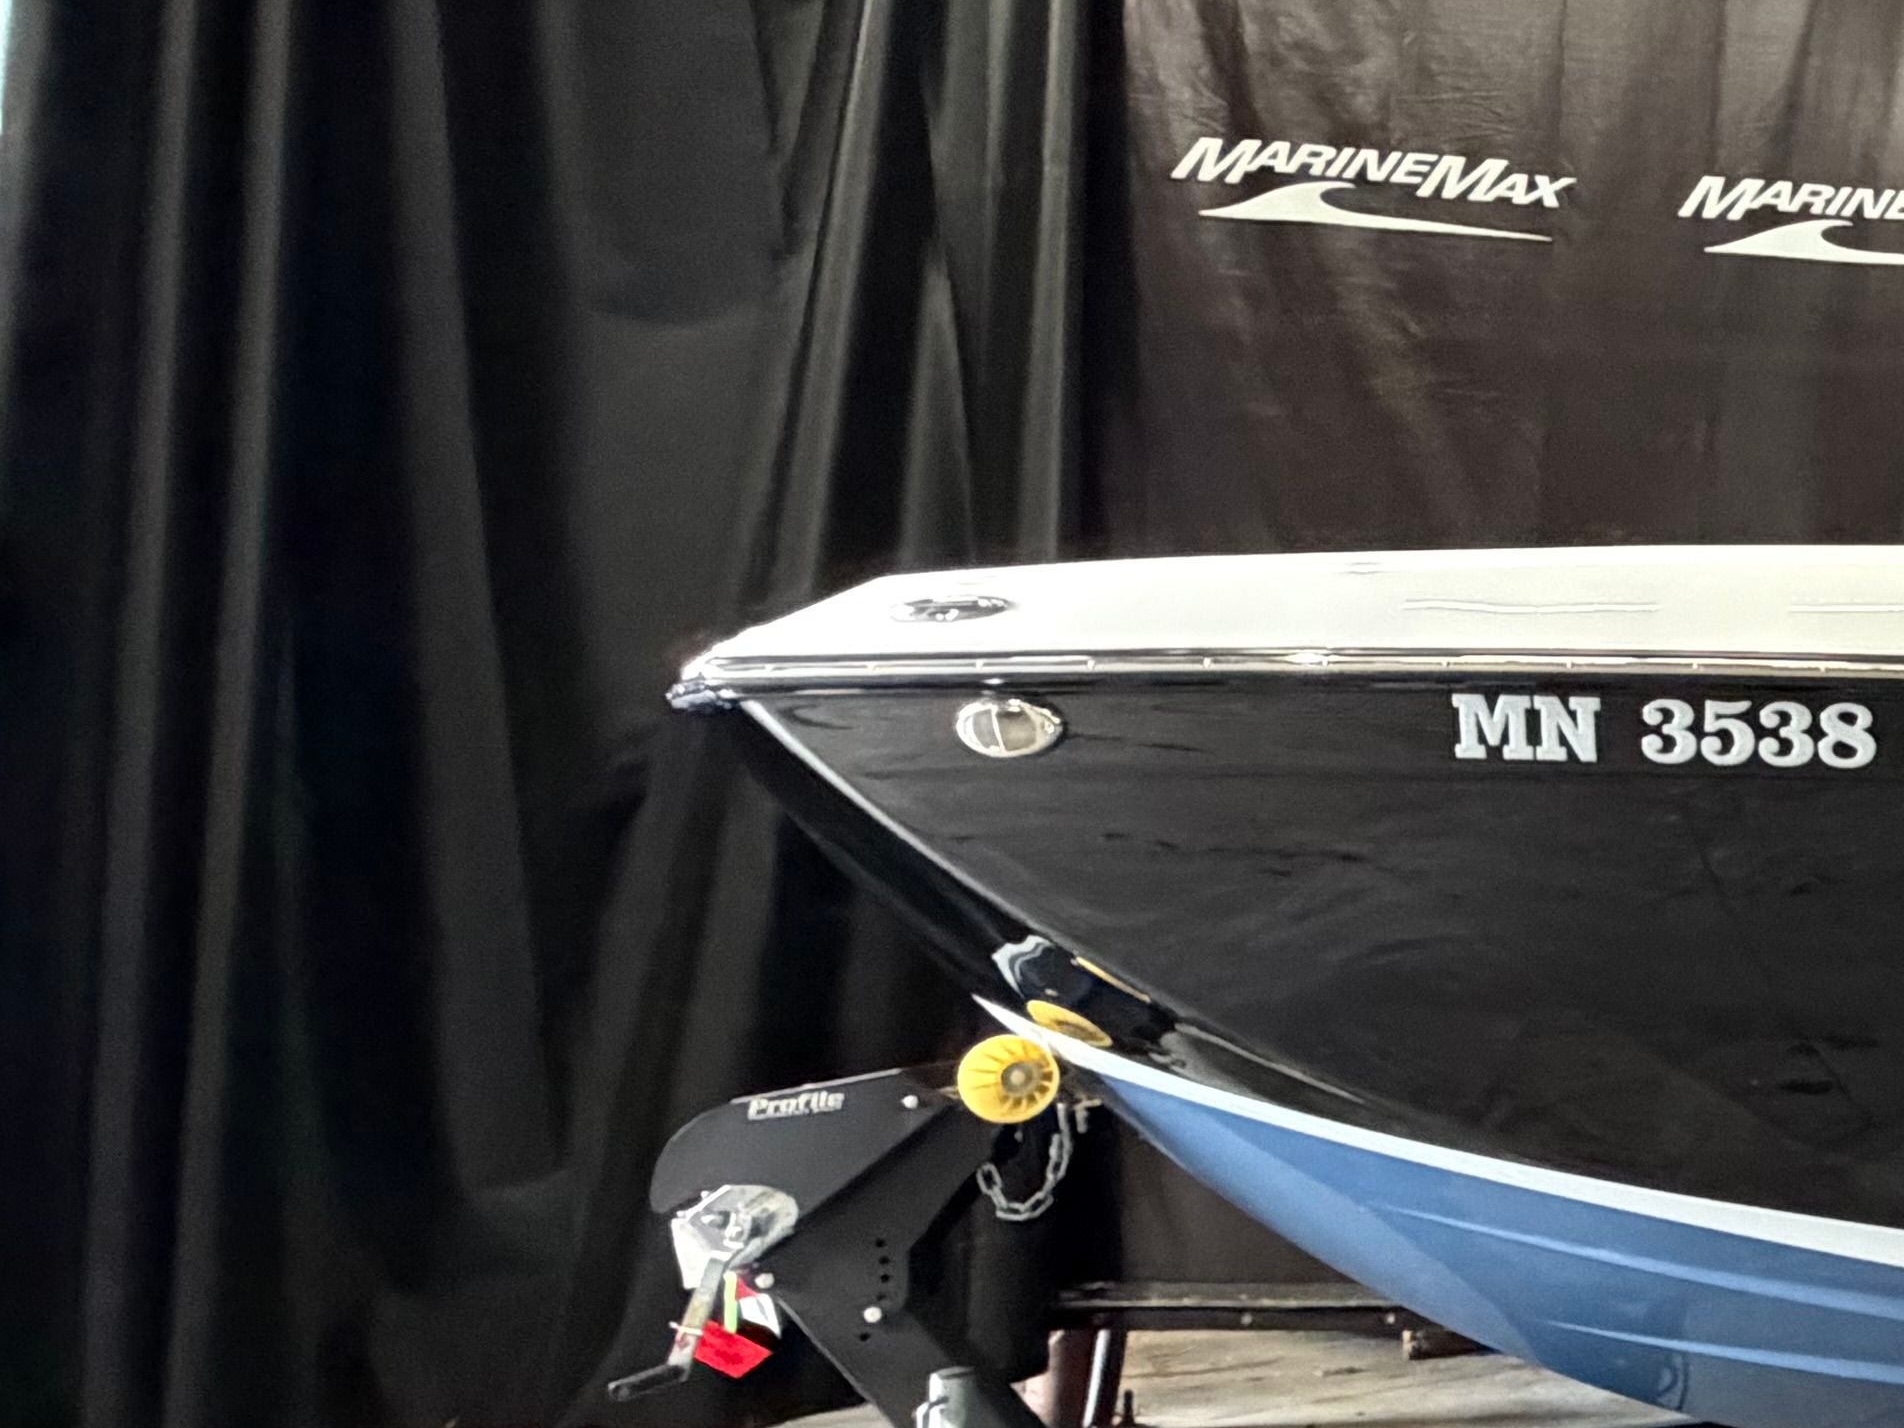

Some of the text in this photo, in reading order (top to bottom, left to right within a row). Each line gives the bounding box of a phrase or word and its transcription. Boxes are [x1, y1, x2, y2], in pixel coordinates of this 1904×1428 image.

[1452, 693, 1600, 763] MN
[1641, 699, 1877, 769] 3538
[747, 1090, 845, 1121] Profile
